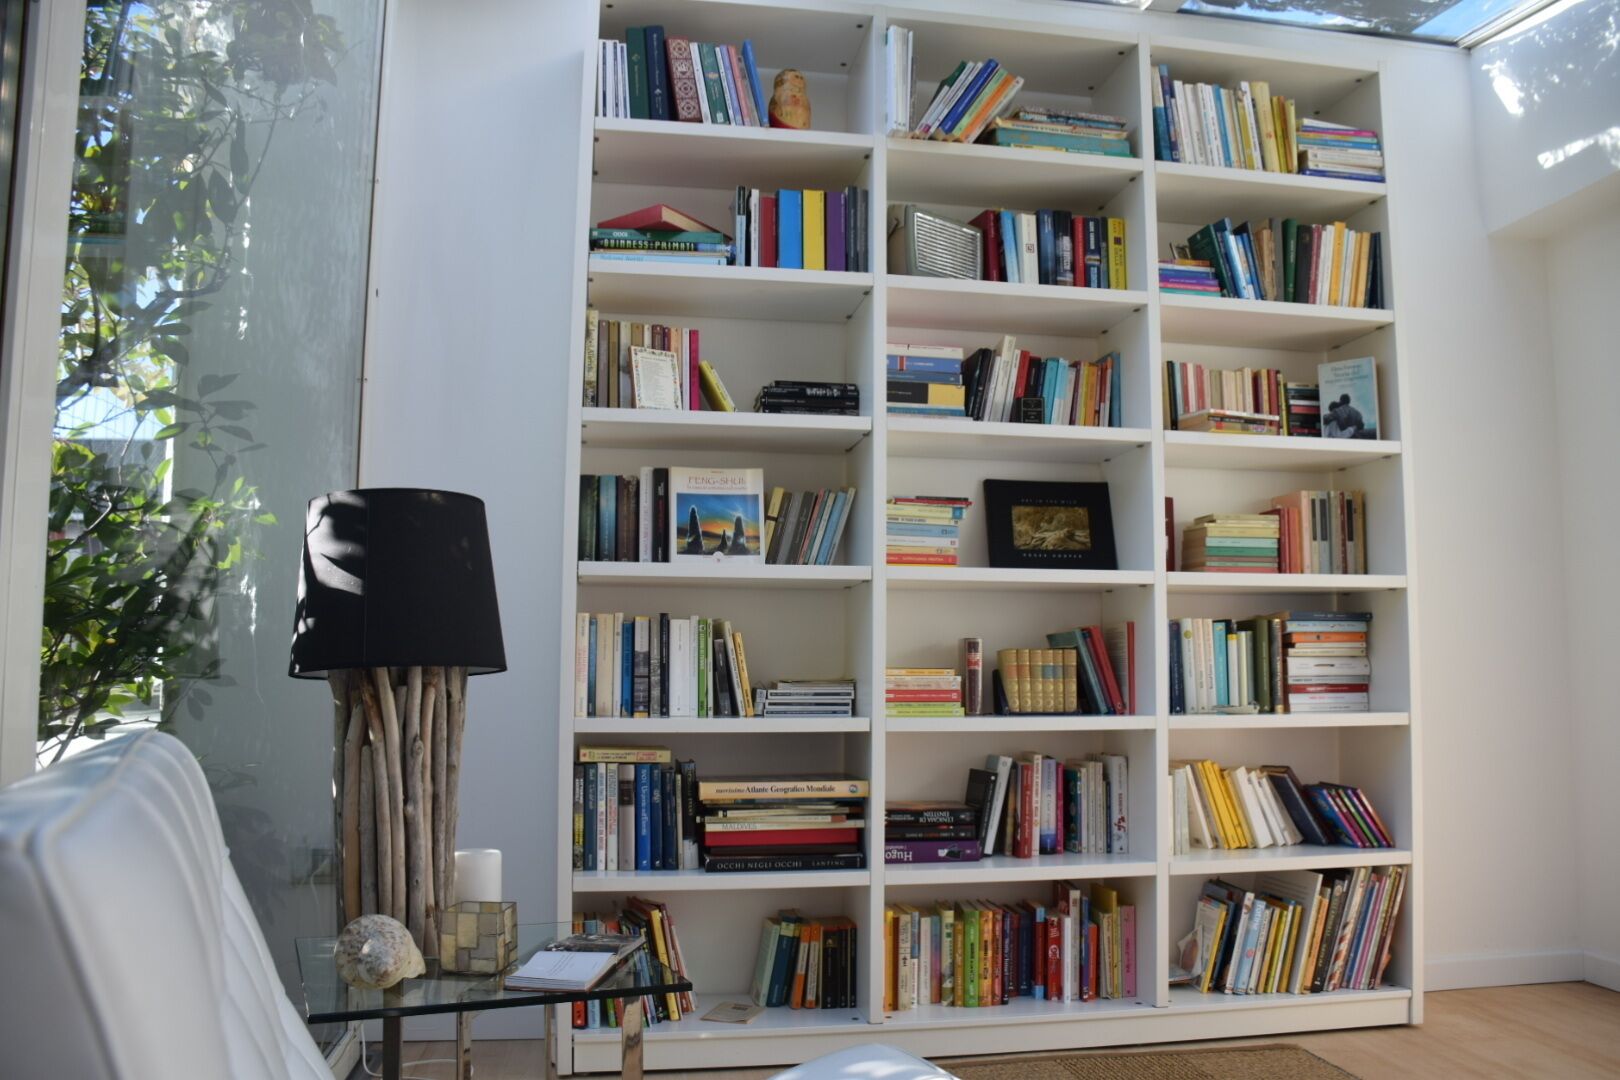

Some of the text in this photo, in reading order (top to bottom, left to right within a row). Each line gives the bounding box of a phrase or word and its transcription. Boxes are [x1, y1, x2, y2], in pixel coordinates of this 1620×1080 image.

[603, 238, 649, 250] GUINNESS
[745, 785, 769, 794] Atlante
[770, 784, 805, 795] Geografico
[806, 784, 836, 793] Mondiale
[885, 850, 913, 861] Hugo
[717, 861, 745, 870] OCCHI
[747, 861, 772, 870] NEGLI
[774, 860, 802, 869] OCCHI
